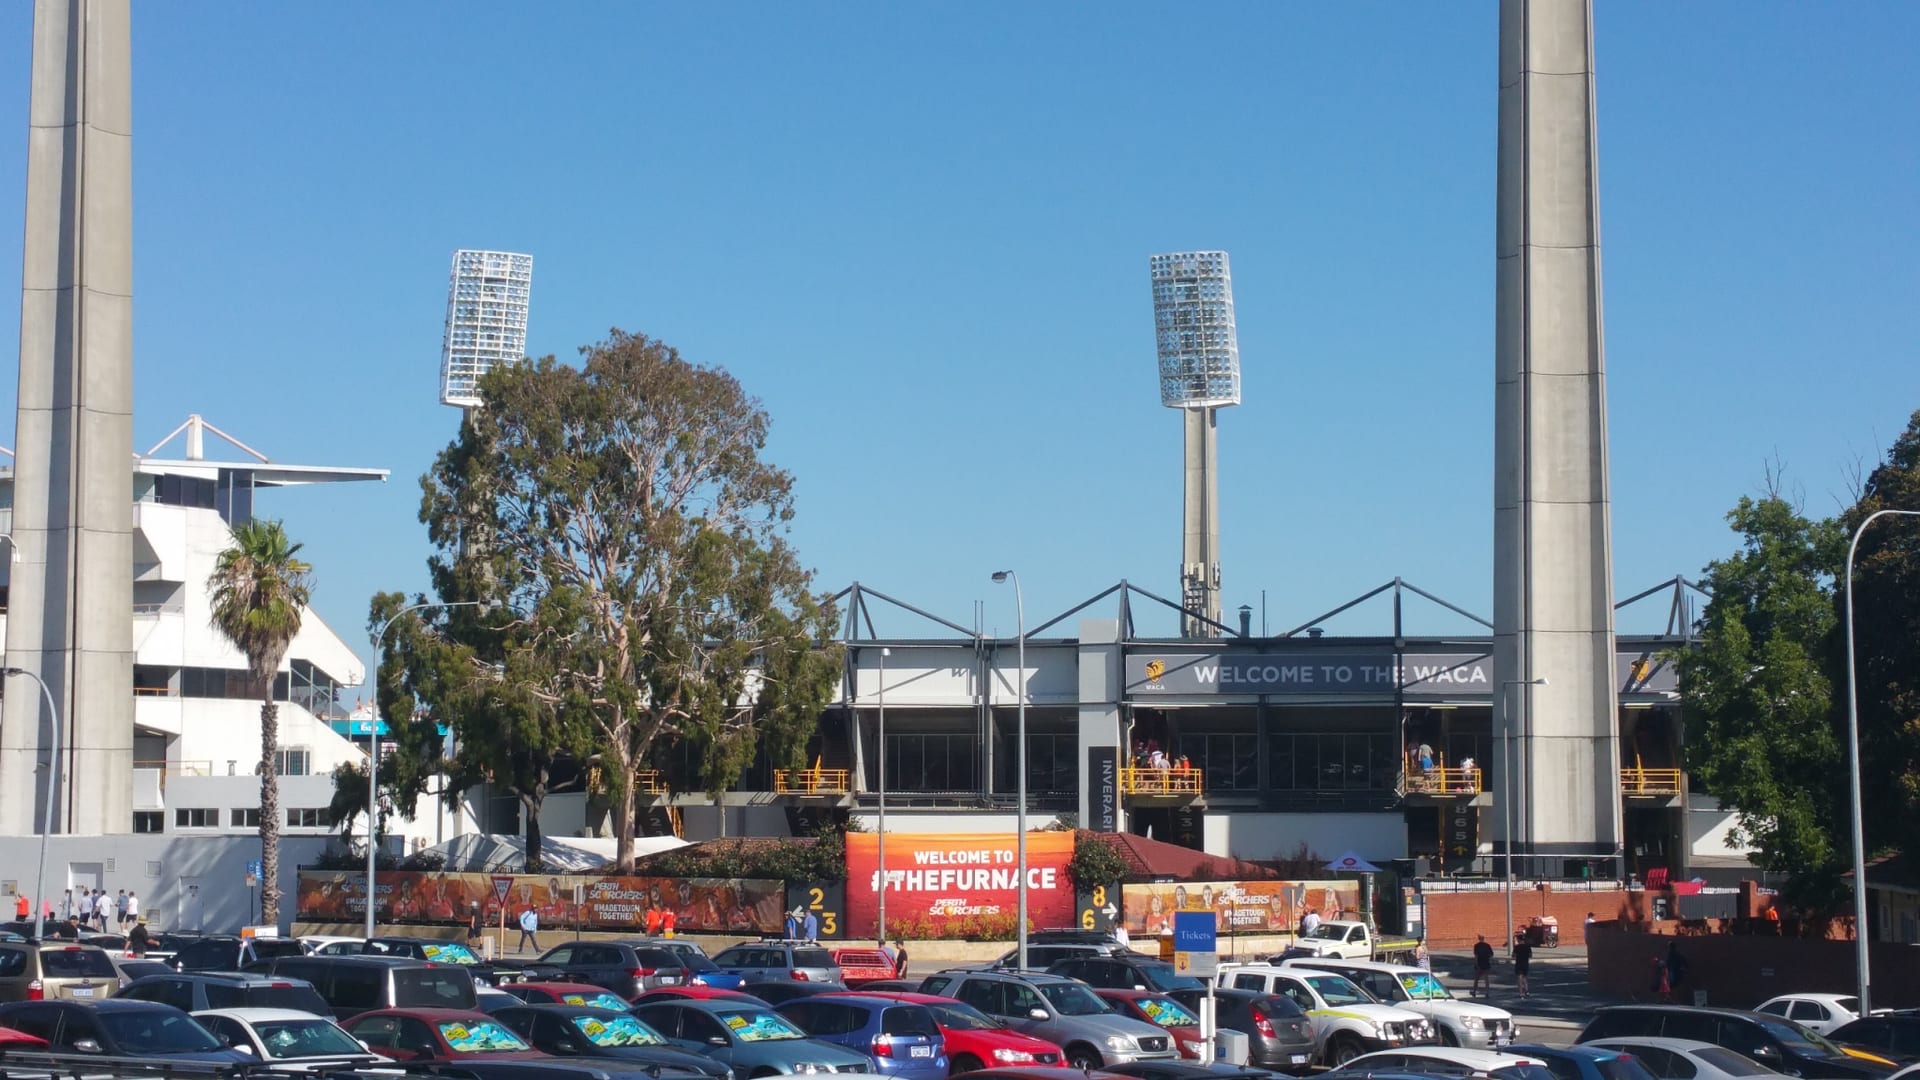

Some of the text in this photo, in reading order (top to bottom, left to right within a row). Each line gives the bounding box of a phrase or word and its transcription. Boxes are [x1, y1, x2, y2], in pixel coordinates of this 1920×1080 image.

[1193, 665, 1487, 684] WELCOME TO THE WACA
[1102, 760, 1113, 832] INVERARI
[914, 850, 1013, 865] WELCOME TO
[594, 882, 619, 890] PERTH
[871, 868, 1056, 892] #THEFURNACE
[589, 890, 645, 900] SCORCHERS
[809, 888, 824, 910] 2
[1093, 885, 1106, 907] 8
[1222, 888, 1246, 896] PTH
[929, 905, 1000, 916] SCORCHERS
[935, 899, 967, 907] PERTH
[599, 912, 634, 920] TOGETHER
[822, 912, 836, 935] 3
[1082, 908, 1095, 931] 6
[1181, 931, 1211, 940] Tickets
